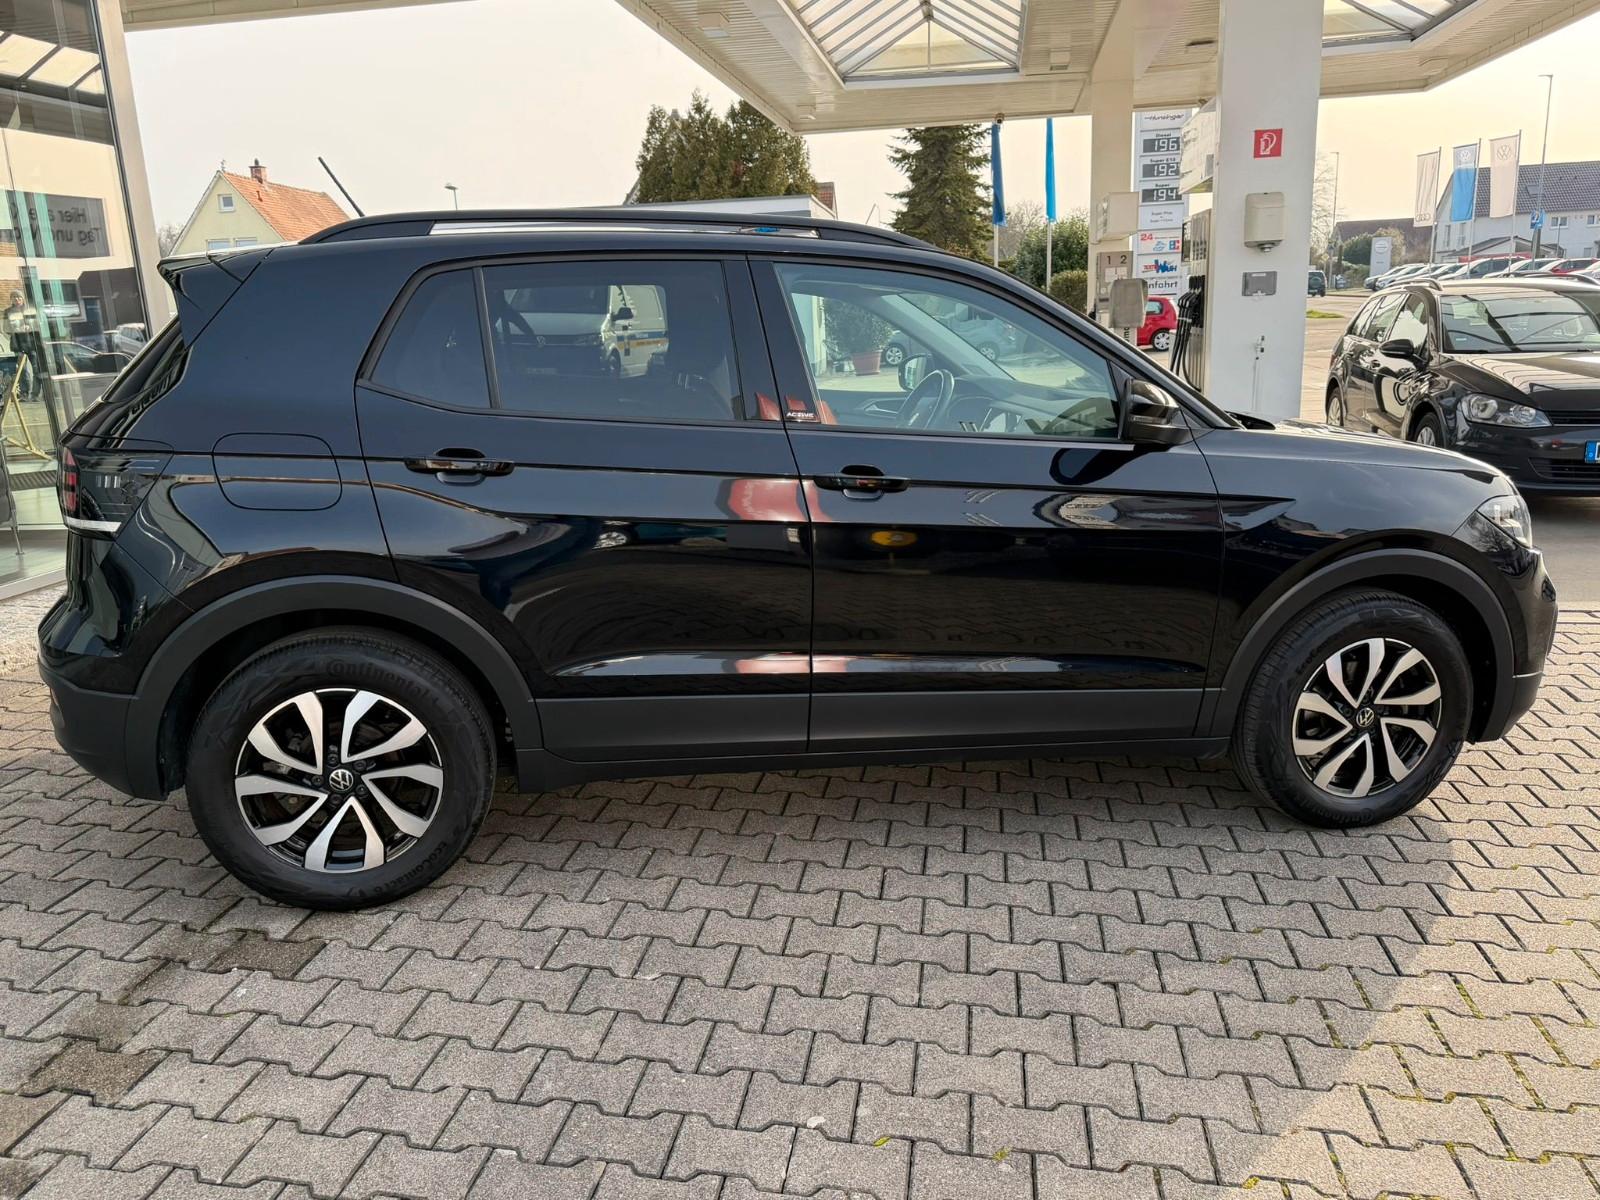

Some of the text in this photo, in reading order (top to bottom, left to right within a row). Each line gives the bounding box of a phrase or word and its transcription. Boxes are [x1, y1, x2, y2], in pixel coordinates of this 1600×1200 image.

[1140, 233, 1153, 241] 24
[1107, 255, 1127, 264] 1 2
